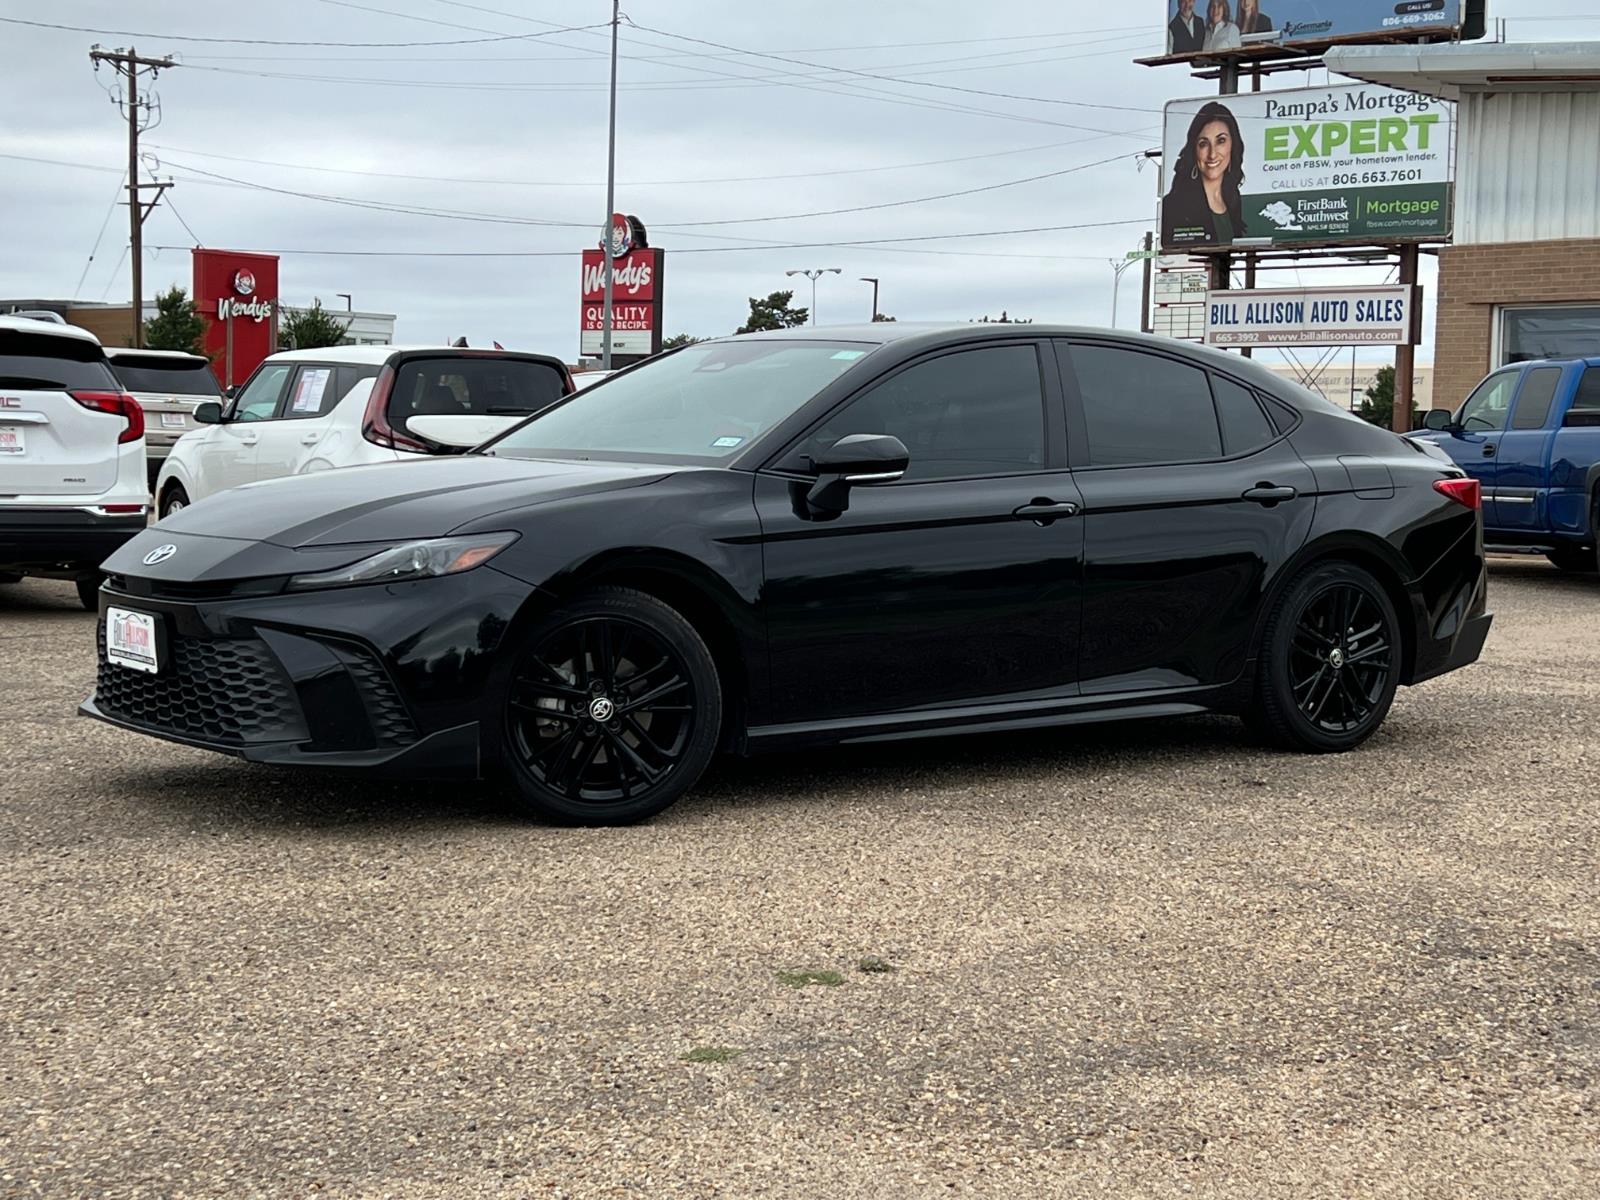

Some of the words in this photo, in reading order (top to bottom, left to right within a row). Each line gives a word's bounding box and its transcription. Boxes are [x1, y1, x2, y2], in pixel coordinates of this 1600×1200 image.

[1297, 20, 1332, 30] Germania
[1382, 12, 1445, 26] 806-669-3062
[1265, 94, 1339, 120] Pampa's
[1264, 114, 1439, 161] EXPERT
[1263, 163, 1288, 172] Count
[1304, 161, 1331, 169] FBSW,
[1334, 159, 1353, 167] your
[1356, 155, 1404, 165] hometown
[1405, 152, 1437, 162] lender.
[1271, 179, 1297, 190] CALL
[1300, 178, 1314, 187] US
[1317, 177, 1330, 186] AT
[1332, 169, 1422, 186] 806.663.7601
[1297, 197, 1348, 211] FirstBank
[1366, 199, 1440, 215] Mortgage
[1297, 210, 1349, 223] Southwest
[218, 295, 272, 322] Wendy's
[1211, 304, 1239, 325] BILL
[1245, 302, 1304, 325] ALLISON
[1310, 300, 1348, 323] AUTO
[1355, 299, 1404, 322] SALES
[587, 321, 595, 330] IS
[597, 321, 614, 330] OR
[616, 321, 647, 330] RECIPE
[1215, 333, 1260, 343] 665-3992
[1267, 331, 1398, 342] www.billallisonauto.com
